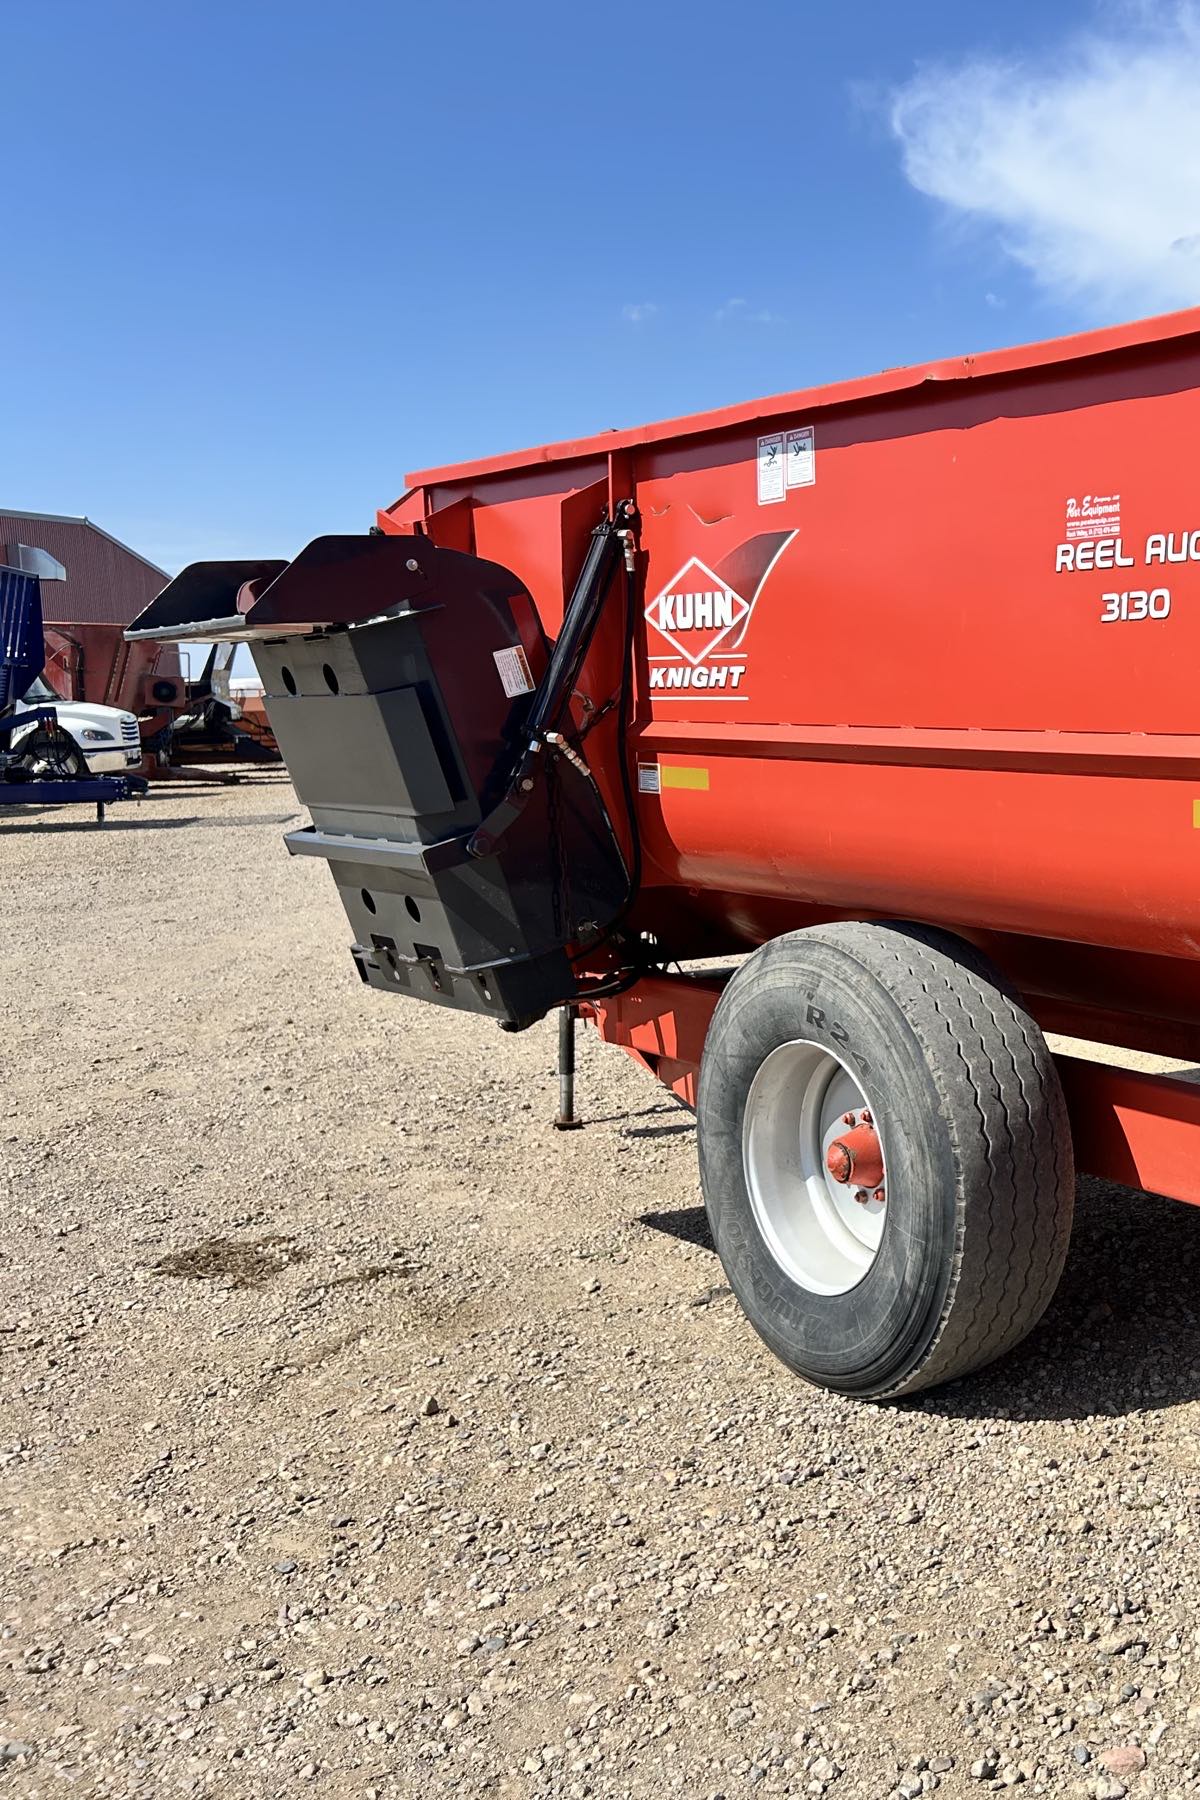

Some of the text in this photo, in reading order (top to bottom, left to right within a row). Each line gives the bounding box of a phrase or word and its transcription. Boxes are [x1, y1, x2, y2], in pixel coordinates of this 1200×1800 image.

[1081, 495, 1120, 517] Equipment
[1056, 539, 1134, 573] REEL
[658, 590, 734, 632] KUHN
[1101, 588, 1171, 623] 3130
[649, 665, 746, 689] KNIGHT
